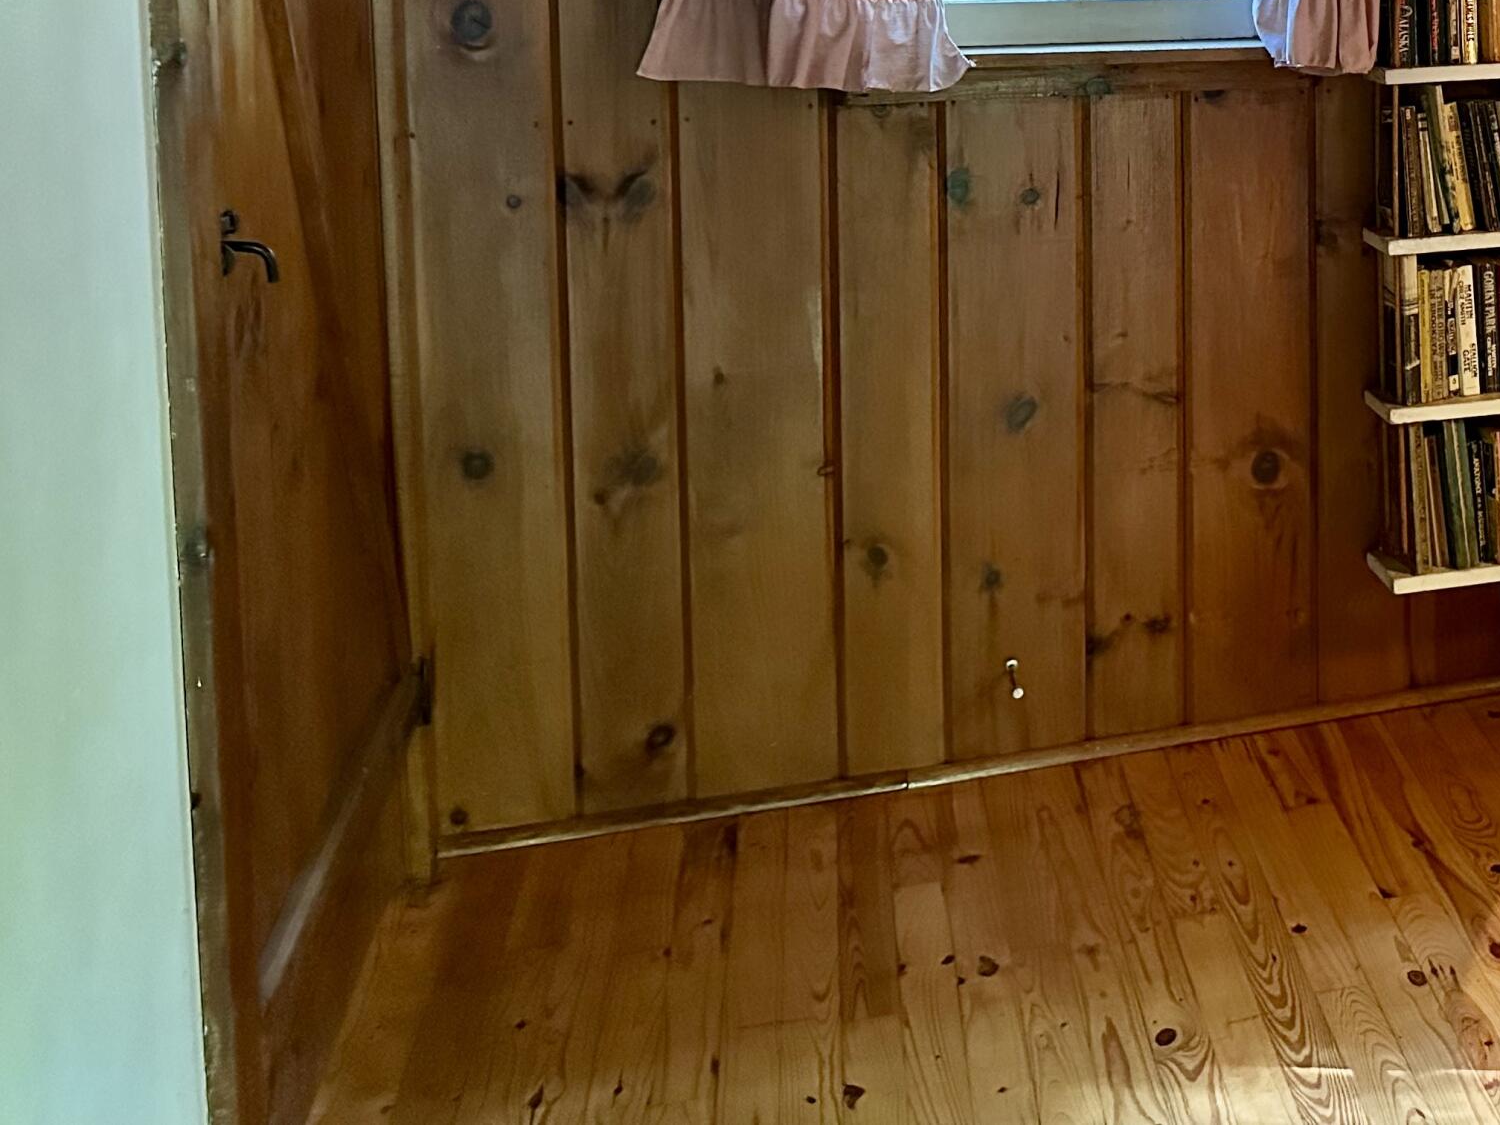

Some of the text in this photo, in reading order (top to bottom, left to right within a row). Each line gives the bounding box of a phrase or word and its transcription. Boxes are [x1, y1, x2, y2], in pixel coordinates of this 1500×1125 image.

[1465, 0, 1474, 21] JAMES
[1399, 17, 1409, 53] ALASKA
[1436, 293, 1444, 319] TREE
[1464, 284, 1473, 319] MARTIN
[1484, 270, 1496, 334] GORKY PARK
[1437, 322, 1445, 358] GROWS
[1463, 349, 1471, 373] GATE
[1470, 342, 1478, 378] STALLION
[1473, 457, 1486, 547] ANATOMY MURDER
